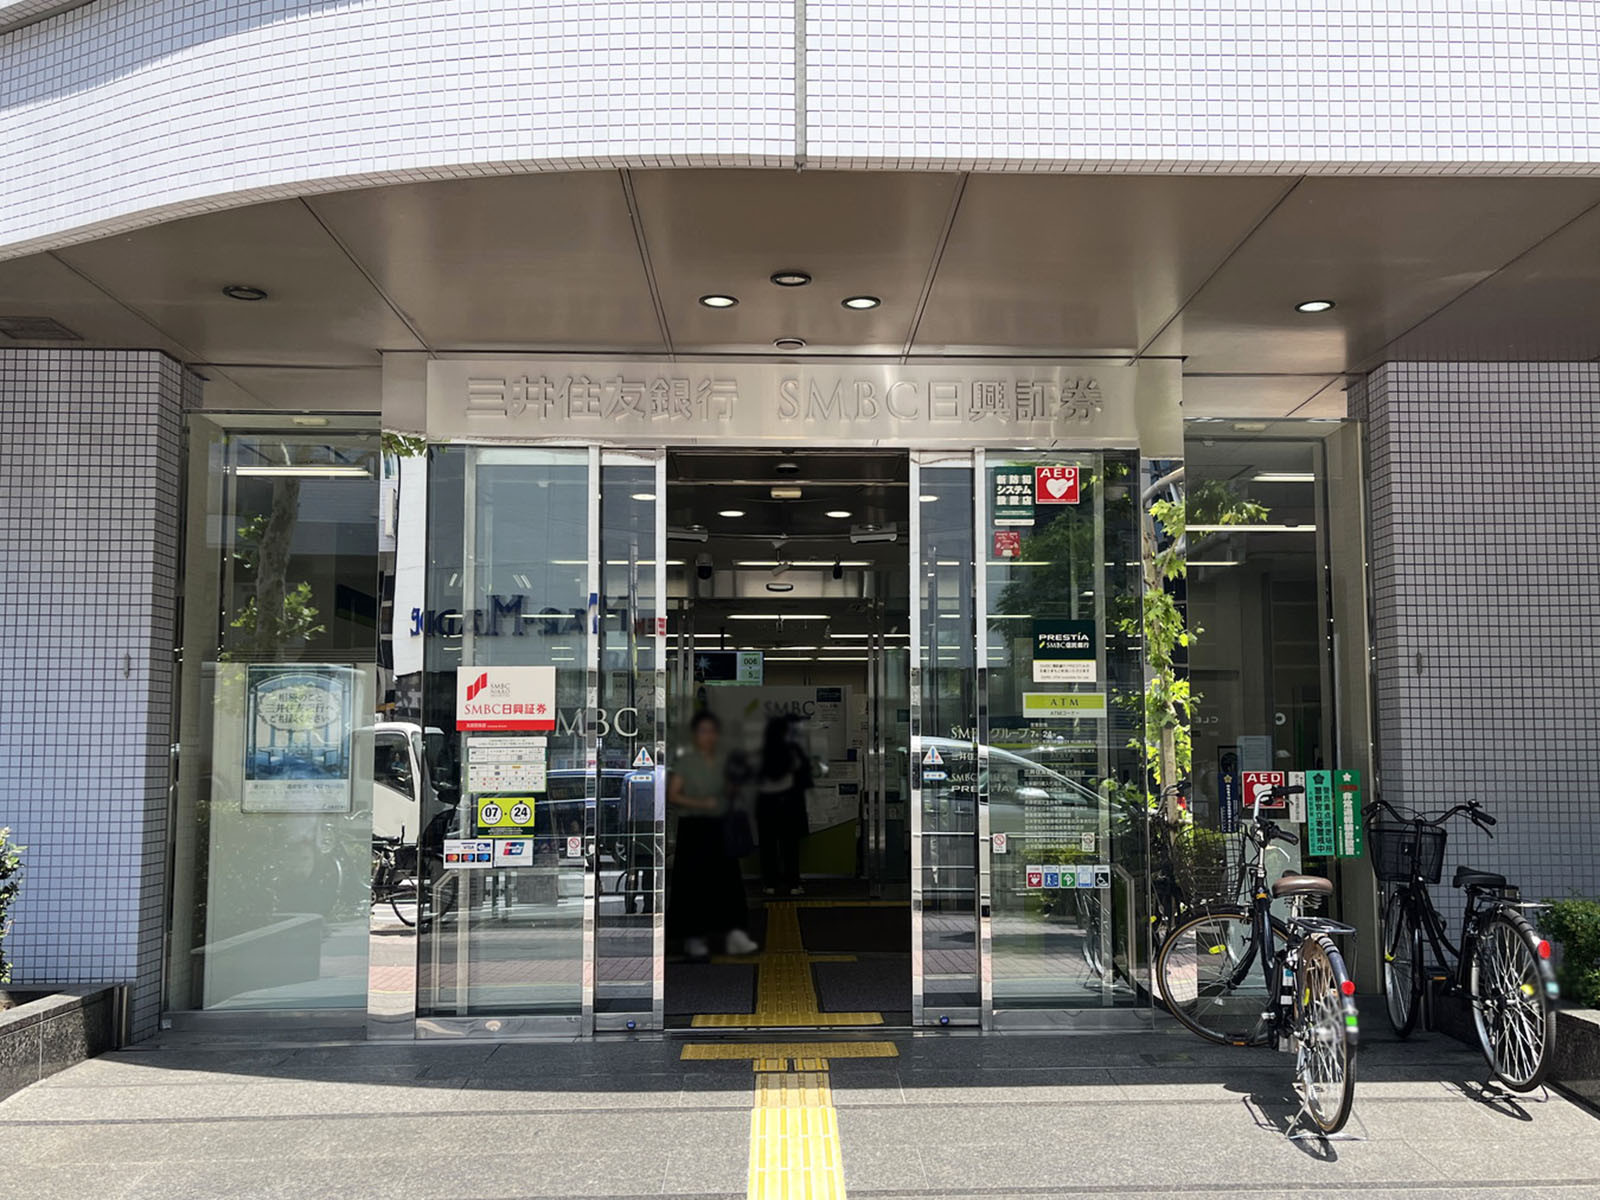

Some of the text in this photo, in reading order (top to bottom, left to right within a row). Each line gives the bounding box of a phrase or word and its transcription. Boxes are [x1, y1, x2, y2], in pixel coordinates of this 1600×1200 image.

[465, 376, 1105, 425] 三井住友銀行 SMBC日興証券
[1039, 468, 1075, 478] AED
[996, 485, 1032, 495] システム
[1050, 698, 1080, 706] ATM
[464, 703, 547, 716] SMBC日興証券
[551, 706, 639, 738] MBC
[1246, 773, 1281, 784] AED
[484, 807, 499, 818] 07
[514, 807, 528, 818] 24
